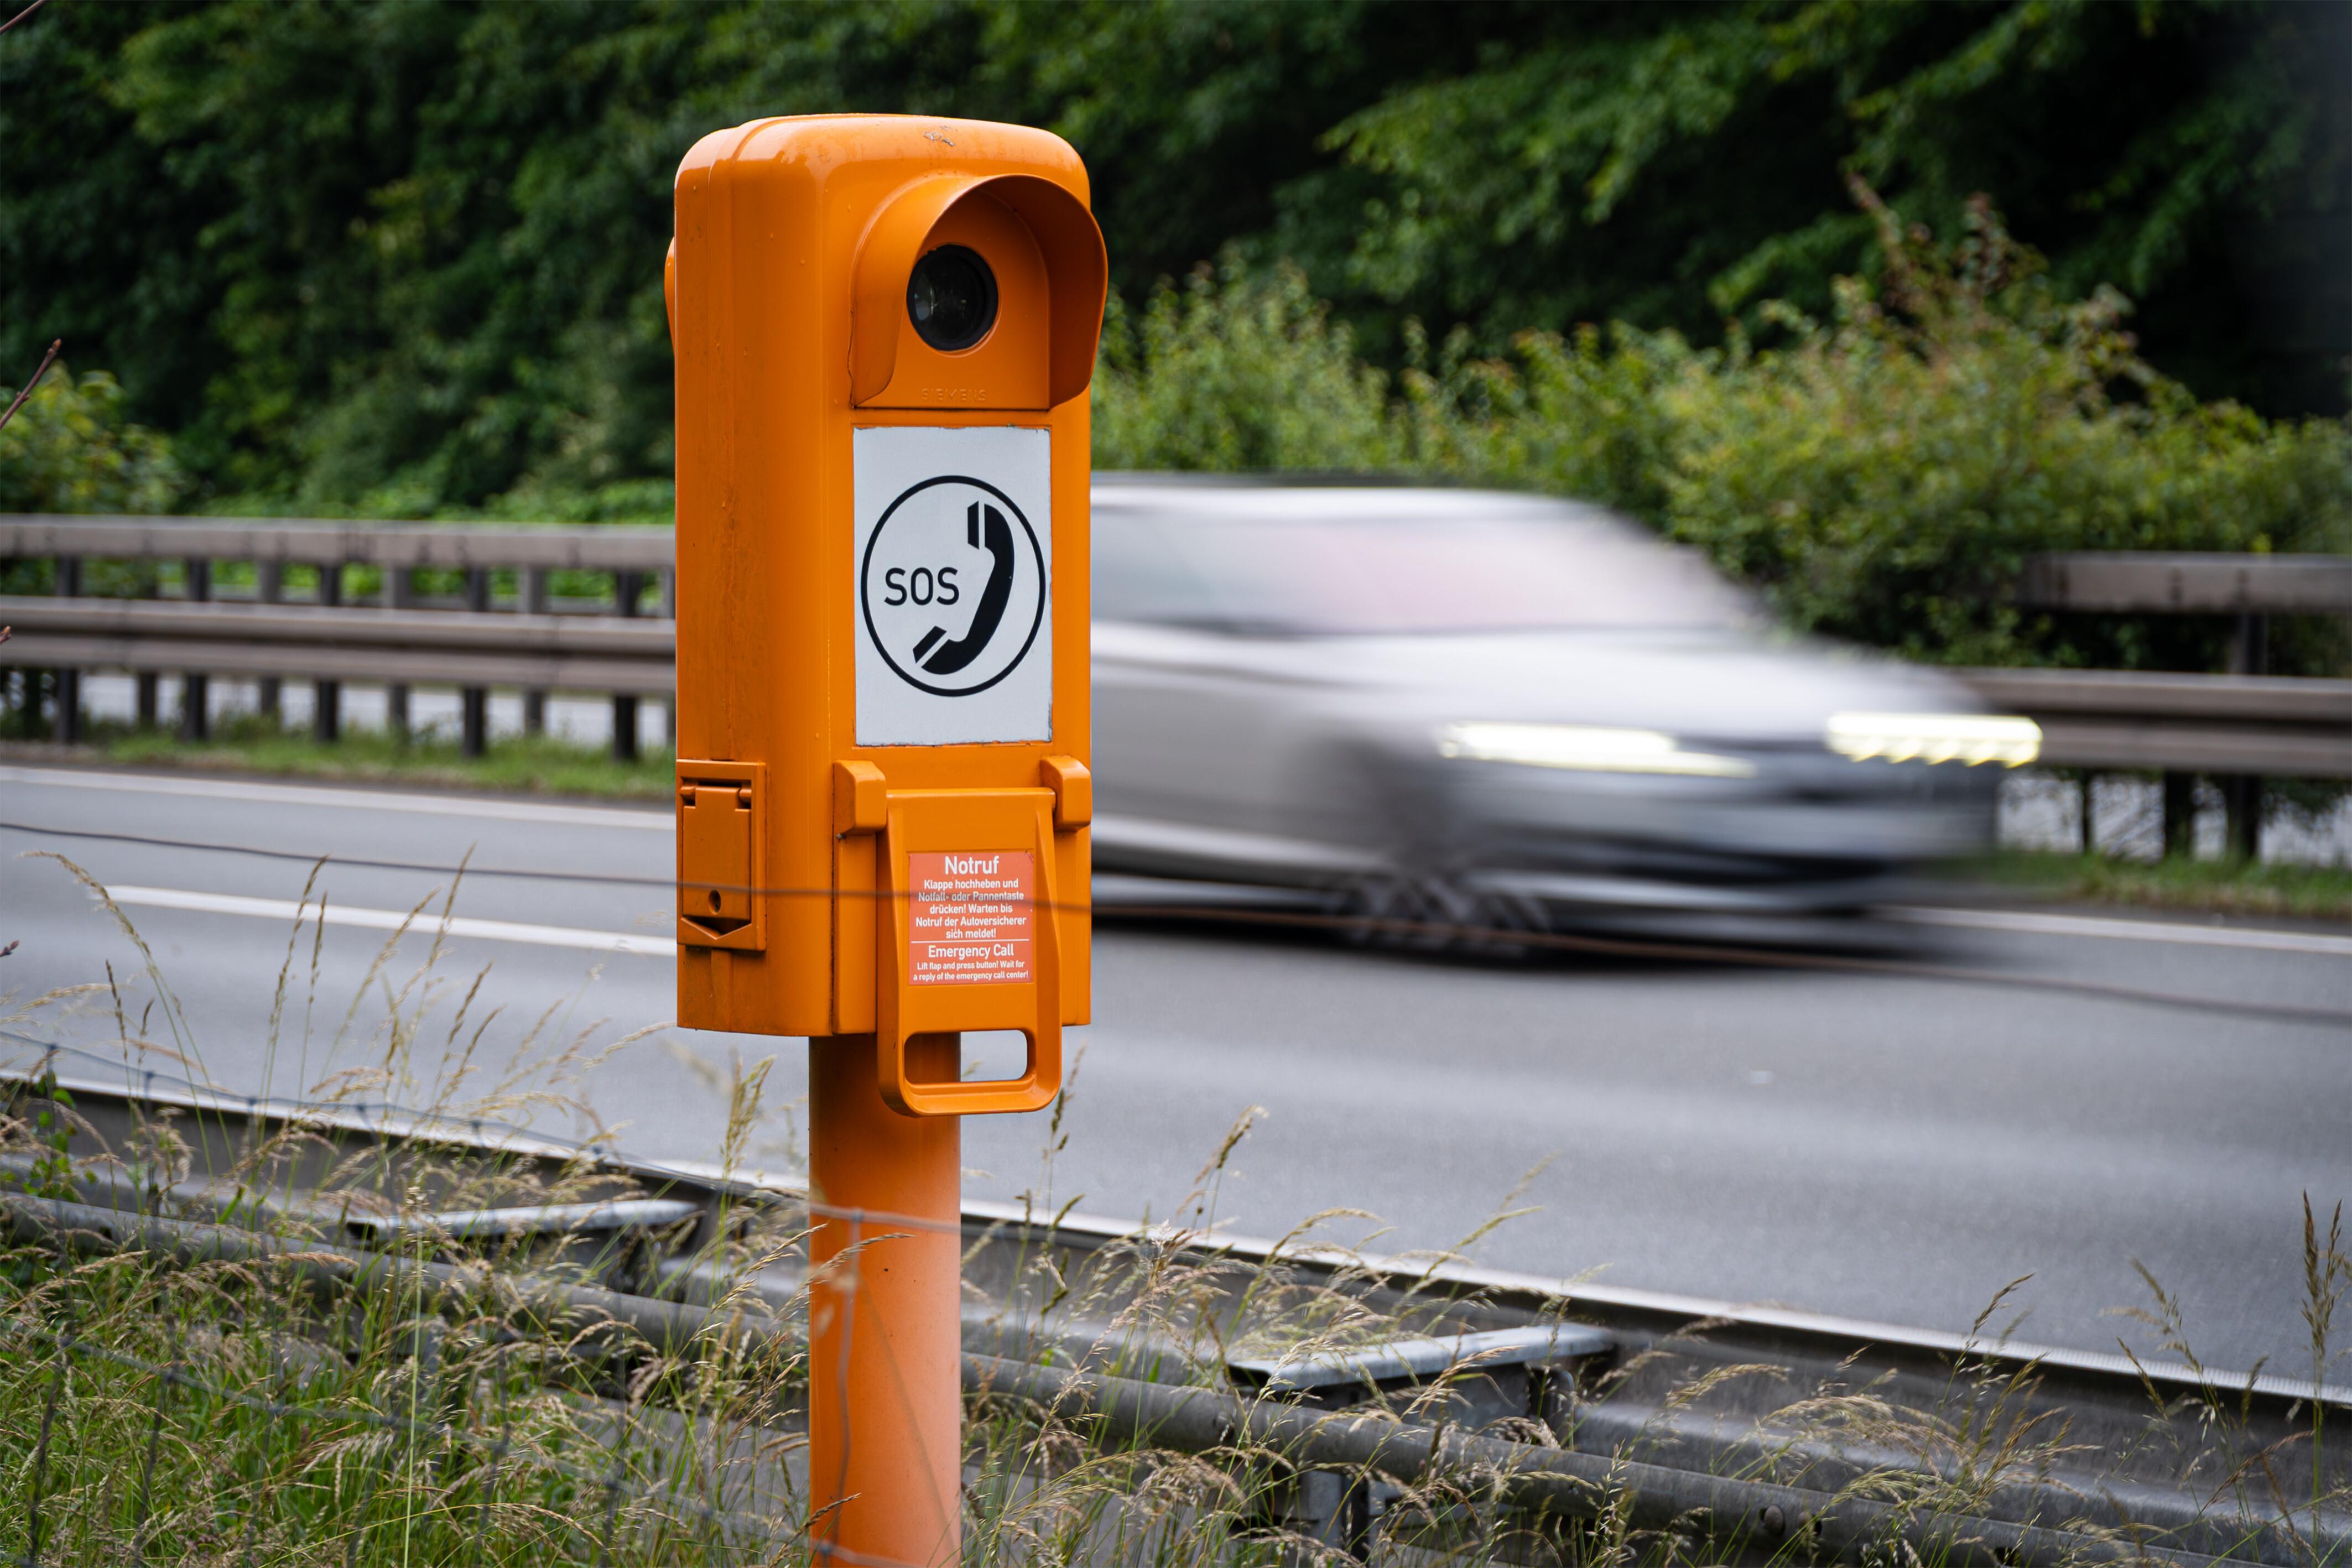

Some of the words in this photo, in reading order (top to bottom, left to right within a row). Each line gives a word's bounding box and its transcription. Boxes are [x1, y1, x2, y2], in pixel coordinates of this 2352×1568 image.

[884, 567, 959, 606] SOS
[945, 856, 999, 874] Notruf
[924, 880, 953, 890] Klappe
[955, 879, 1000, 889] hochheben
[1003, 879, 1018, 888] und
[918, 892, 949, 902] Notfall-
[952, 892, 970, 900] oder
[974, 892, 1024, 900] Pannentaste
[930, 904, 966, 914] drücken!
[969, 904, 998, 913] Warten
[1001, 904, 1012, 912] bis
[916, 917, 942, 926] Notruf
[945, 917, 958, 926] der
[960, 916, 1026, 925] Autoversicherer
[946, 929, 962, 938] sich
[965, 928, 996, 937] meldet!
[929, 945, 990, 960] Emergency
[993, 944, 1014, 956] Call
[929, 962, 941, 971] flap
[919, 973, 935, 981] reply
[956, 972, 992, 981] emergency
